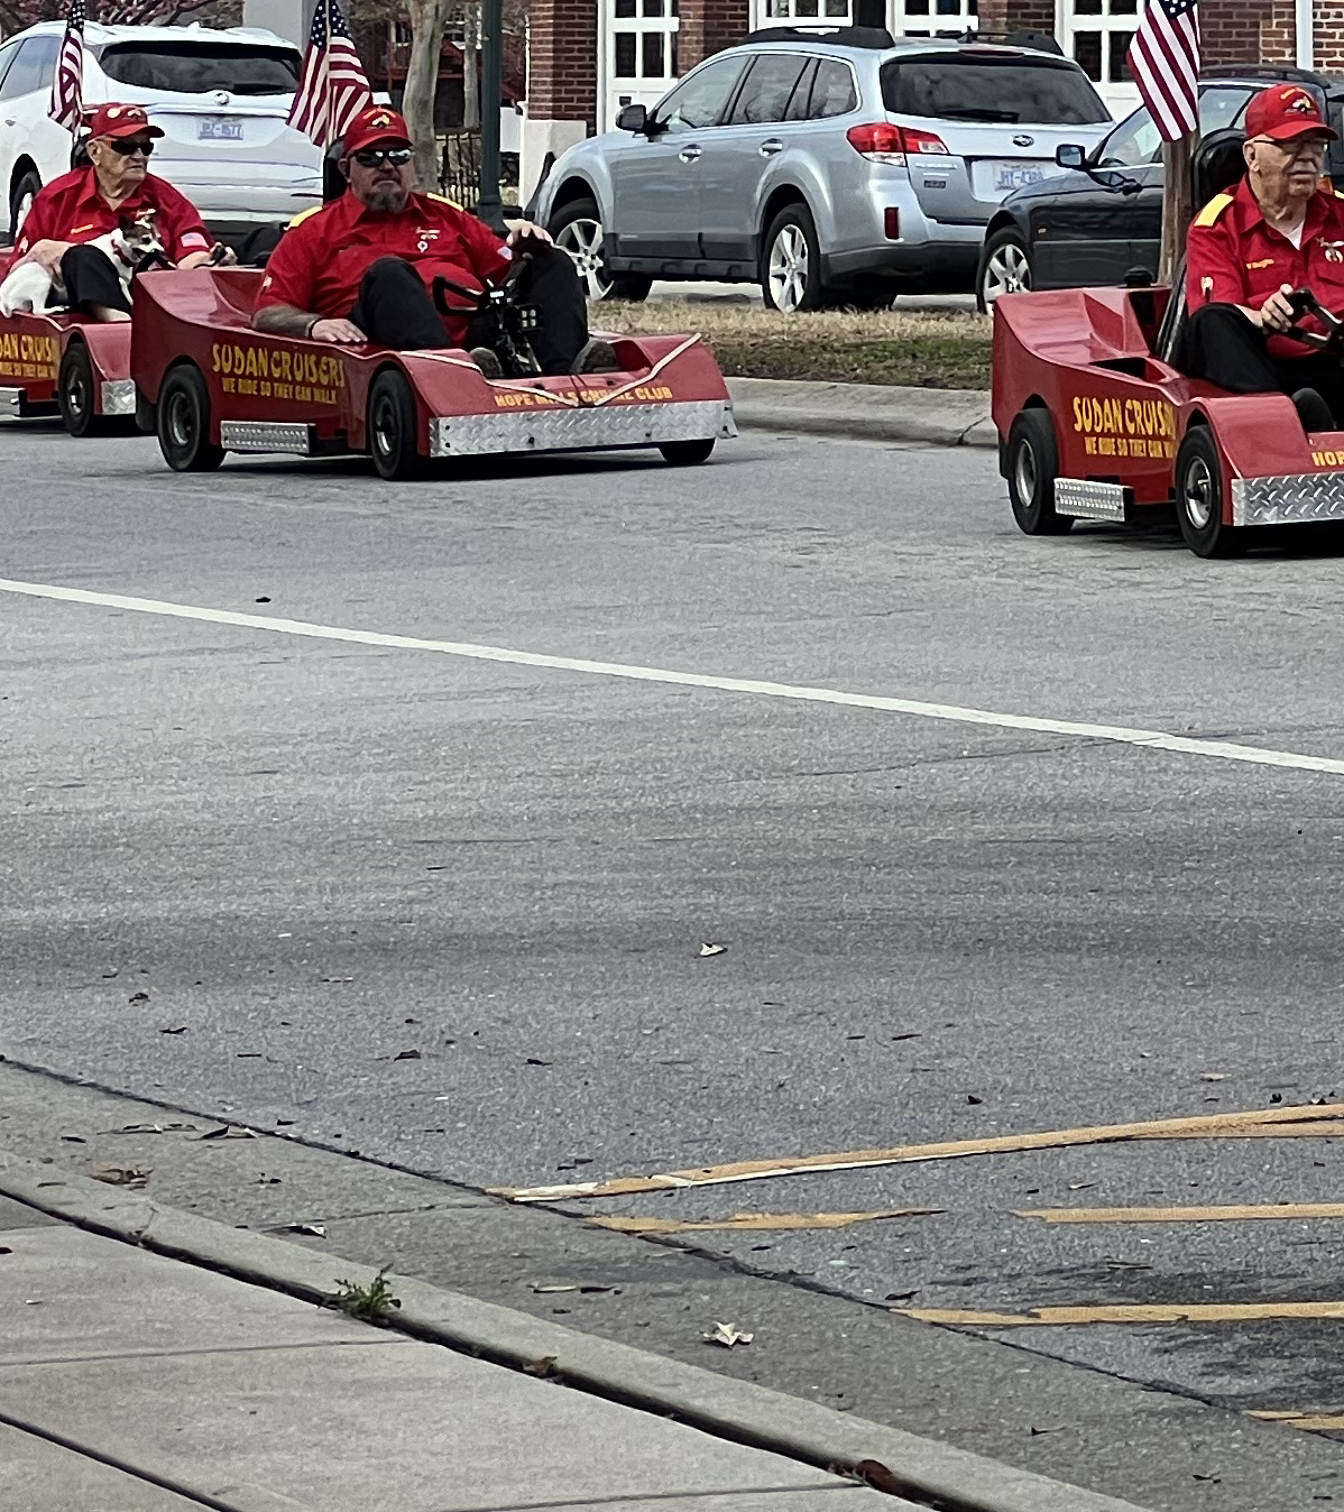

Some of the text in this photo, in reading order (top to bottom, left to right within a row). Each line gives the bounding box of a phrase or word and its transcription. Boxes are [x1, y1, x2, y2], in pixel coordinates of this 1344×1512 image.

[212, 344, 268, 377] SUDAN
[494, 394, 534, 407] HOPE
[639, 387, 672, 400] CLUB
[1073, 397, 1122, 433] SUDAN
